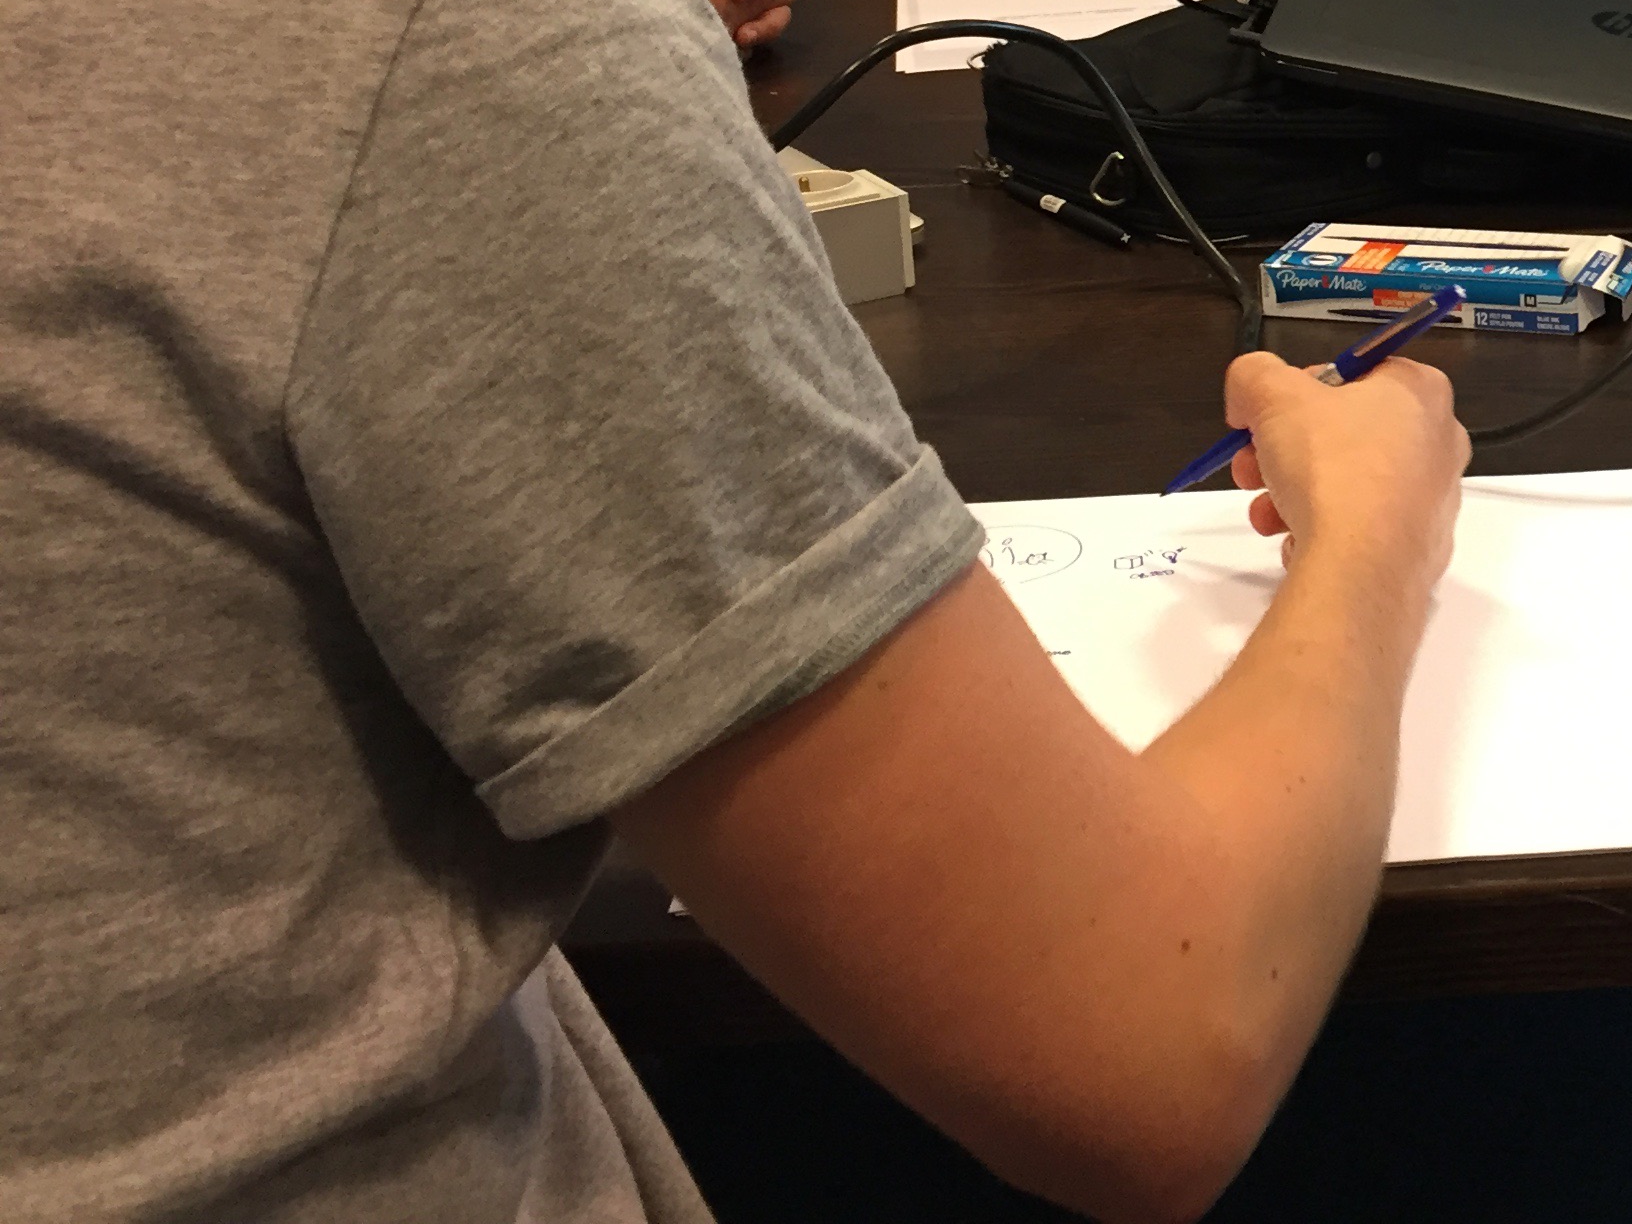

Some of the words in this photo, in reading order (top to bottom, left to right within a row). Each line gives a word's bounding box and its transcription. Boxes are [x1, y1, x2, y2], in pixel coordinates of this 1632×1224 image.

[1416, 260, 1483, 274] Paper
[1491, 265, 1550, 277] Mate
[1276, 269, 1323, 292] Paper
[1328, 274, 1367, 292] Mate
[1475, 311, 1488, 326] 12
